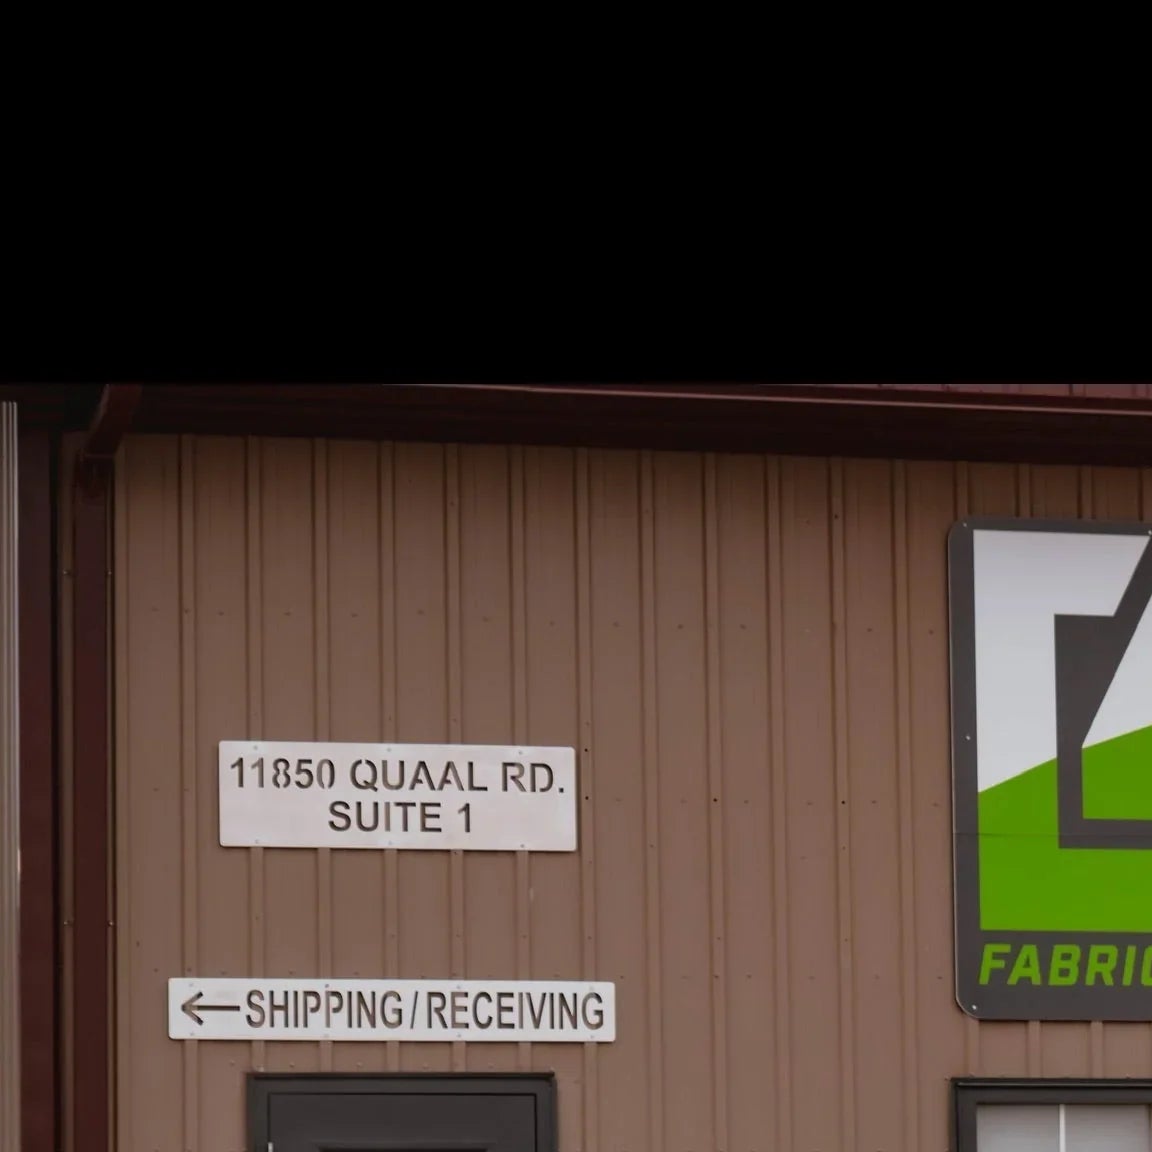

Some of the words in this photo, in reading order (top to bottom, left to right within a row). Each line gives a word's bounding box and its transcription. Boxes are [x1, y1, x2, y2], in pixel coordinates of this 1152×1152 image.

[230, 756, 335, 789] 11850
[350, 758, 488, 792] QUAAL
[501, 761, 565, 794] RD.
[327, 800, 442, 833] SUITE
[457, 802, 471, 834] 1
